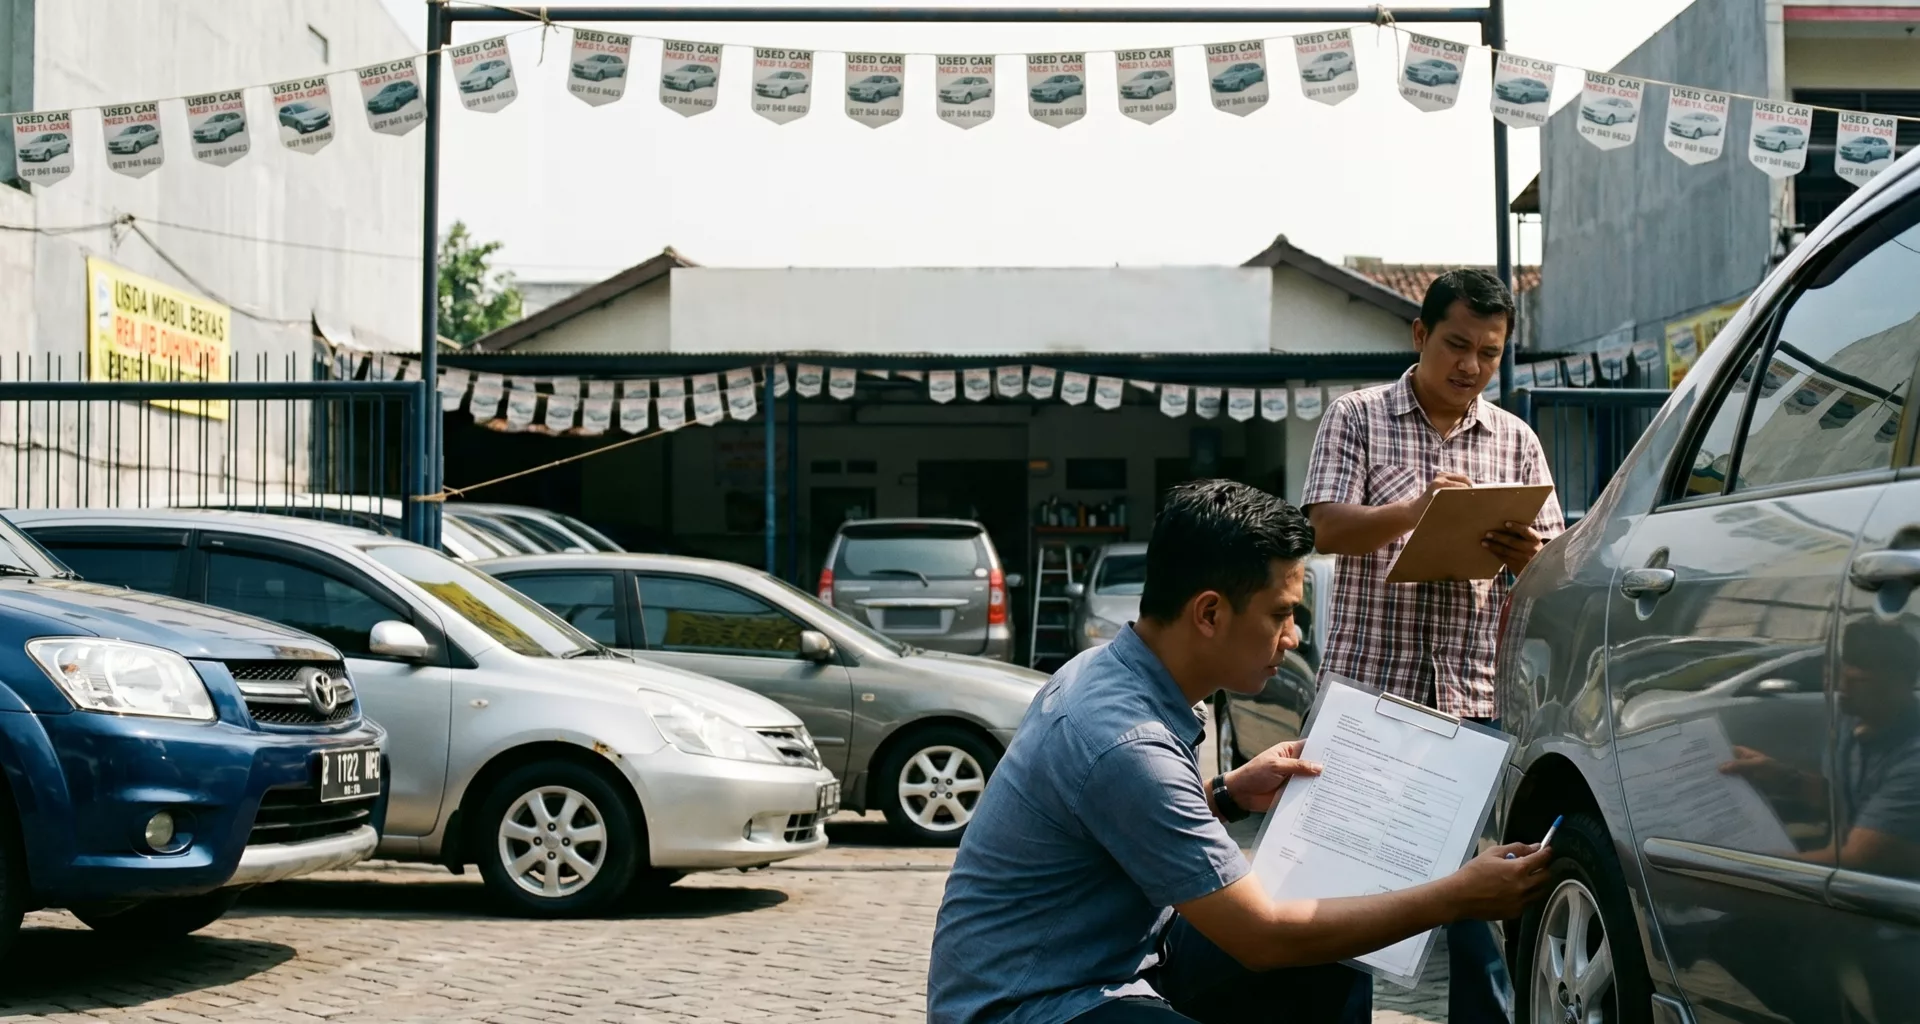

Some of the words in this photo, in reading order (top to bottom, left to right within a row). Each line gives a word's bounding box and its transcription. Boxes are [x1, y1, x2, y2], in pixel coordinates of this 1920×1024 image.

[576, 32, 604, 42] USED
[607, 36, 629, 45] CAR
[1296, 35, 1324, 45] USED
[1327, 31, 1349, 41] CAR
[1412, 35, 1440, 48] USED
[1443, 43, 1465, 54] CAR
[452, 45, 480, 58] USED
[483, 39, 505, 51] CAR
[666, 42, 694, 51] USED
[697, 45, 719, 54] CAR
[757, 50, 785, 59] USED
[789, 51, 811, 60] CAR
[1208, 45, 1236, 55] USED
[1239, 42, 1261, 52] CAR
[848, 55, 876, 64] USED
[880, 56, 902, 64] CAR
[938, 57, 966, 65] USED
[970, 57, 992, 65] CAR
[1029, 55, 1057, 64] USED
[1060, 55, 1083, 63] CAR
[1118, 52, 1146, 61] USED
[1149, 51, 1171, 59] CAR
[360, 66, 387, 79] USED
[390, 60, 412, 72] CAR
[1500, 55, 1528, 67] USED
[1532, 62, 1553, 72] CAR
[273, 83, 301, 94] USED
[304, 78, 325, 89] CAR
[1587, 75, 1615, 86] USED
[1618, 80, 1640, 90] CAR
[188, 96, 216, 106] USED
[220, 92, 241, 103] CAR
[1673, 89, 1700, 99] USED
[1704, 94, 1726, 104] CAR
[103, 107, 131, 117] USED
[134, 104, 156, 115] CAR
[1756, 102, 1784, 113] USED
[1787, 107, 1809, 117] CAR
[16, 114, 44, 124] USED
[47, 113, 69, 122] CAR
[1841, 114, 1869, 124] USED
[1873, 118, 1893, 128] CAR
[152, 294, 186, 330] MOBIL
[191, 308, 223, 341] BEKAS
